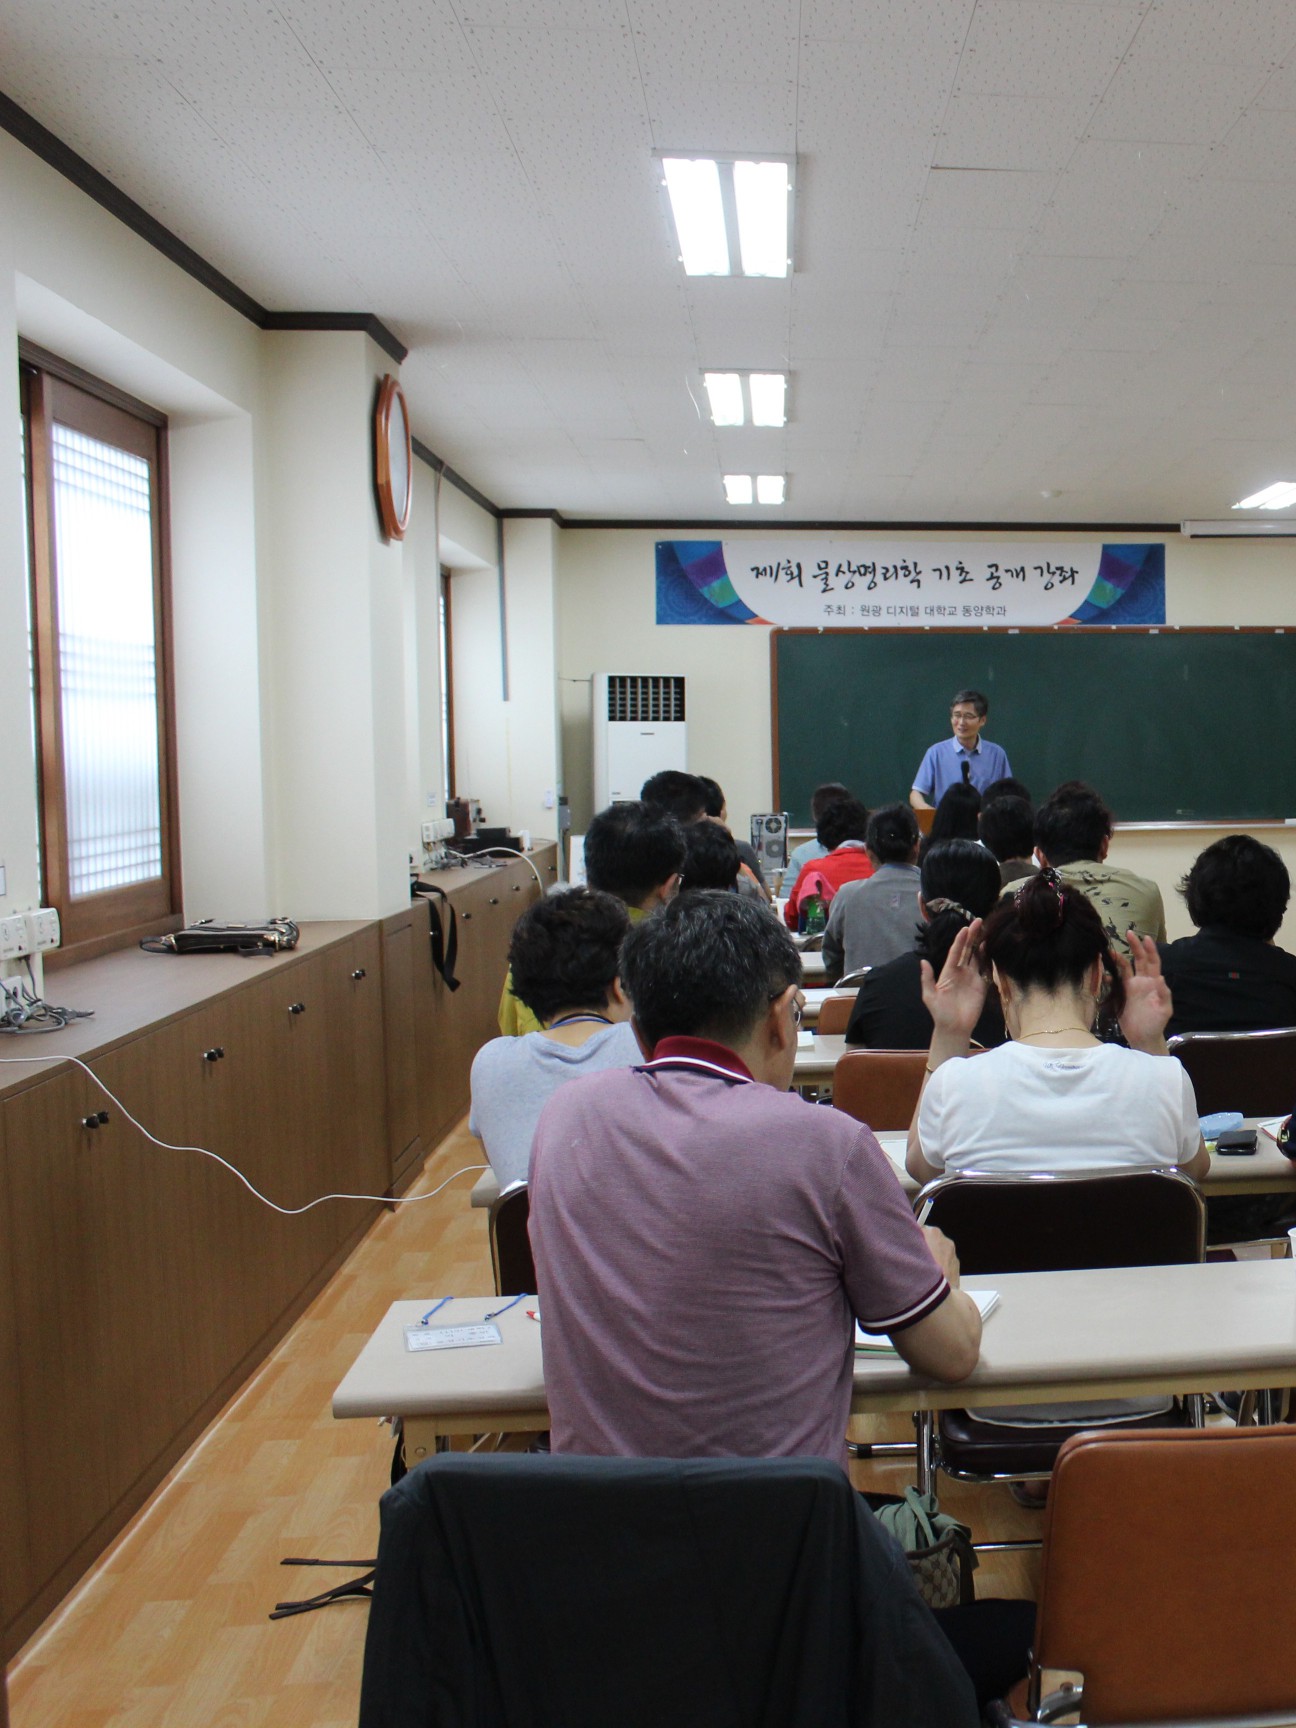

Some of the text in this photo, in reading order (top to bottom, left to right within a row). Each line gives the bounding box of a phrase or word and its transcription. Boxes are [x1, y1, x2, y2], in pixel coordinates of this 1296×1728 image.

[750, 559, 1079, 594] 제1회 물상명리학 기초 공개 강좌
[823, 604, 847, 616] 주최
[859, 604, 882, 617] 원광
[886, 604, 920, 617] 디지털
[924, 604, 957, 617] 대학교
[961, 604, 1007, 617] 동양학과
